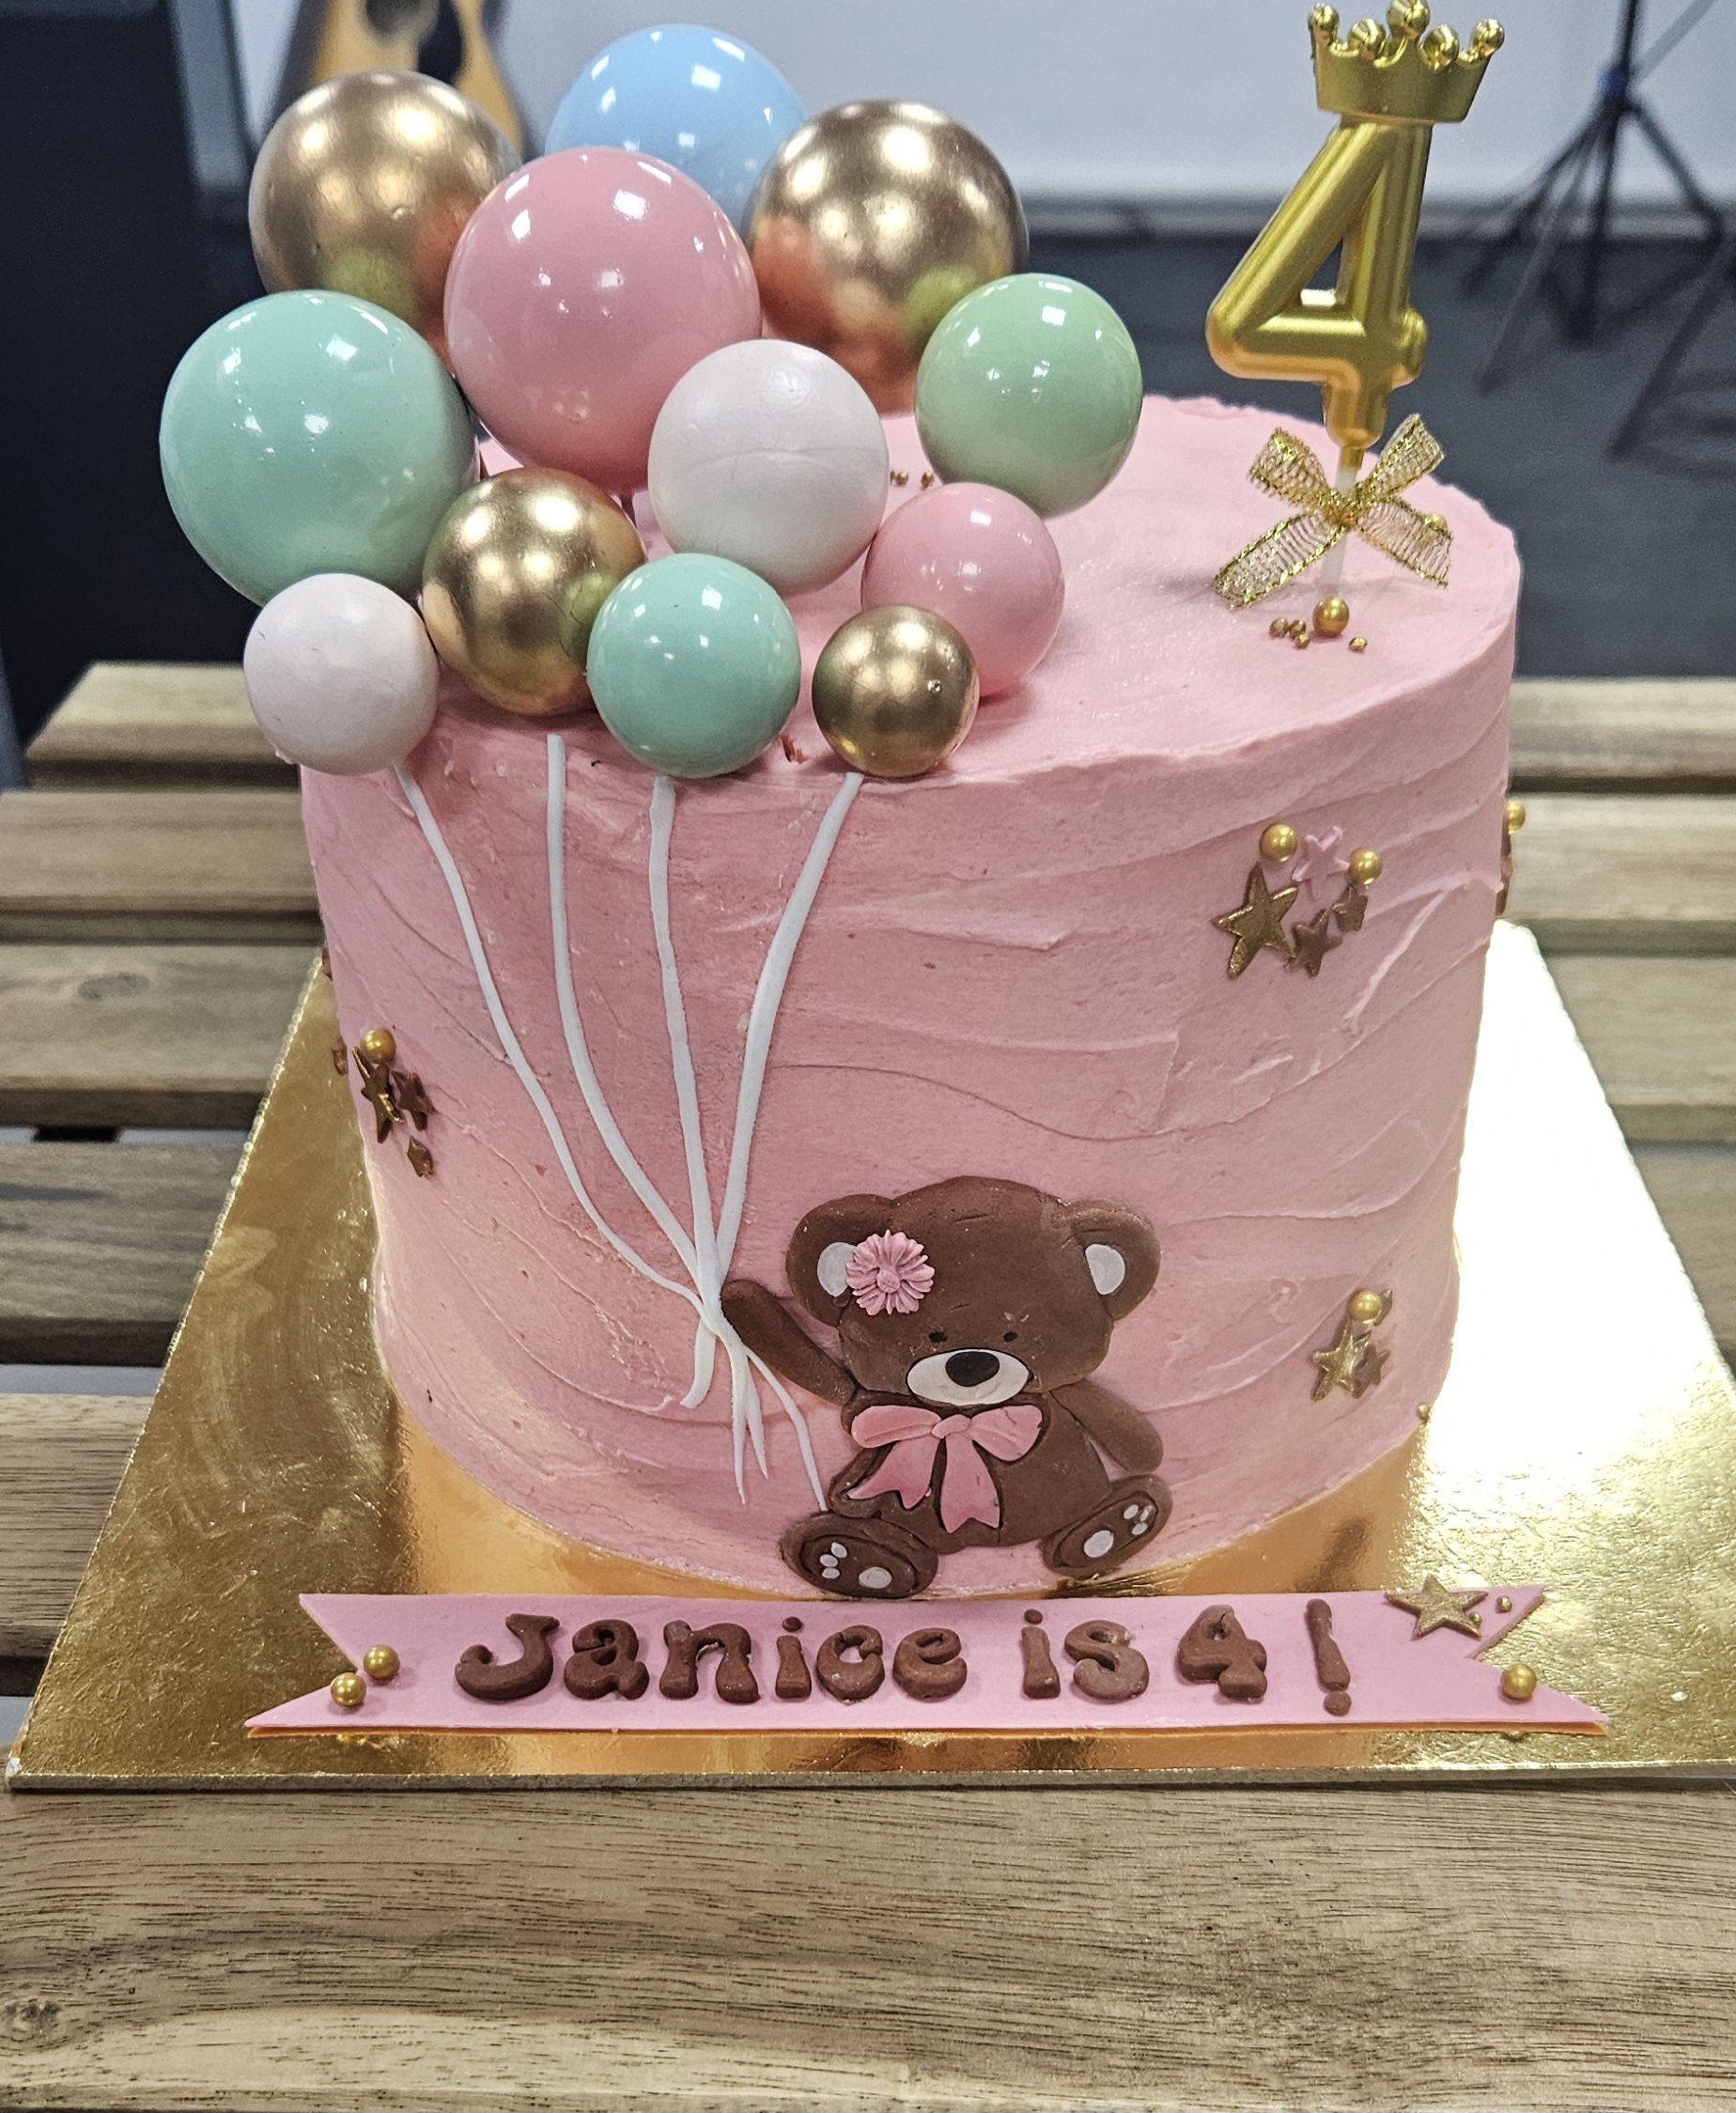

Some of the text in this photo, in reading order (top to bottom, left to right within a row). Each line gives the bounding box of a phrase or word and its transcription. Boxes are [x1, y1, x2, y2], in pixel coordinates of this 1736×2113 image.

[1205, 117, 1432, 449] 4
[456, 1613, 968, 1703] Janice
[1020, 1608, 1150, 1701] is
